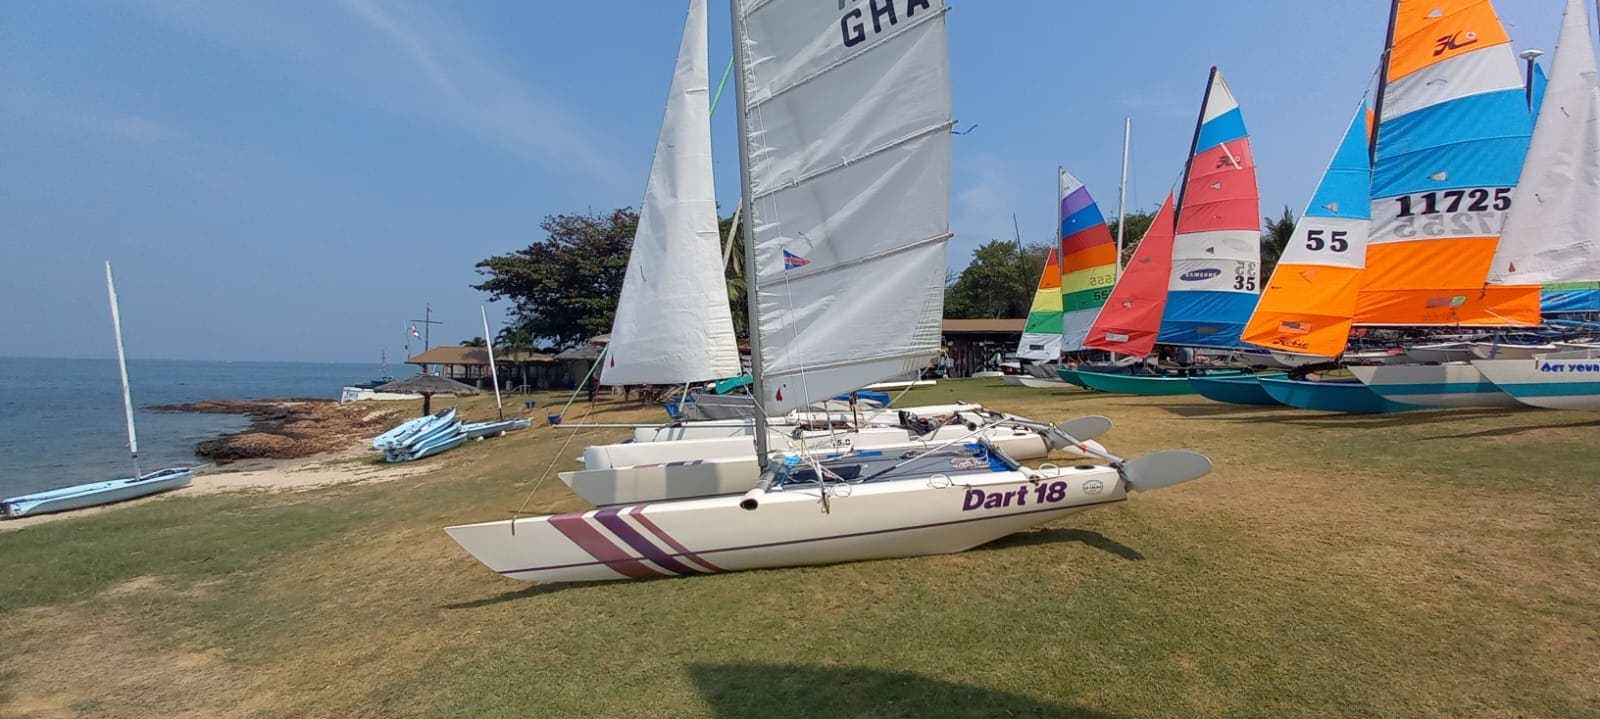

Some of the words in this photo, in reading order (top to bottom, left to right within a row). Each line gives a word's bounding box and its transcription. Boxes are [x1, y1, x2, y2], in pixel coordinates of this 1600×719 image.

[1395, 188, 1512, 217] 11725
[1306, 230, 1349, 252] 55
[1233, 275, 1256, 291] 35
[962, 485, 1028, 512] Dart
[1034, 481, 1068, 504] 18
